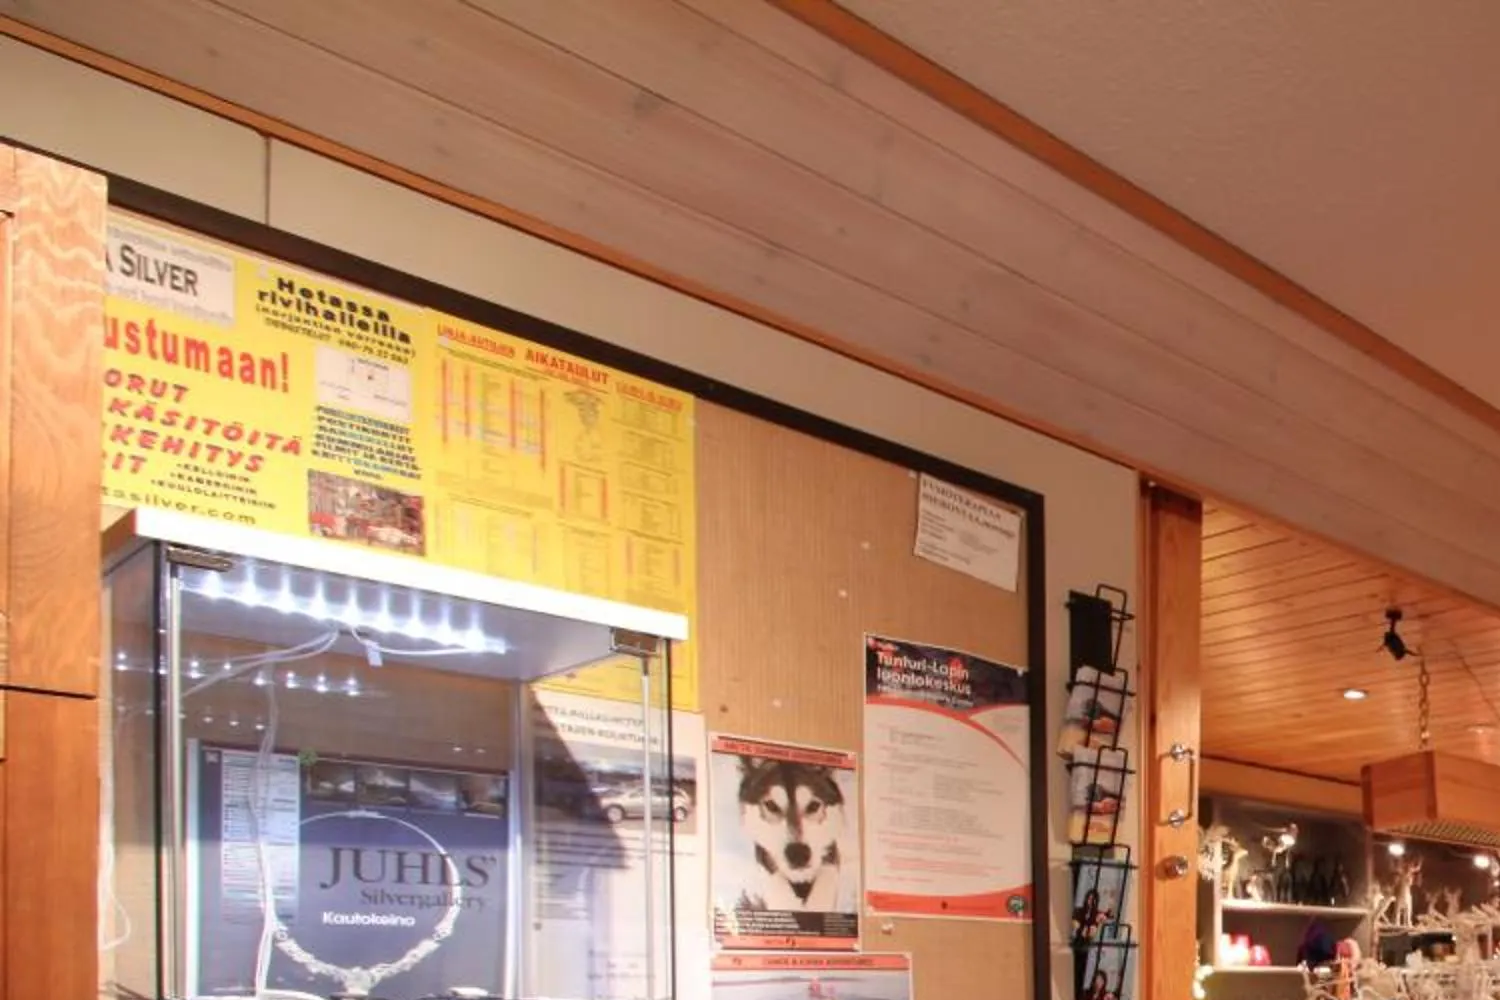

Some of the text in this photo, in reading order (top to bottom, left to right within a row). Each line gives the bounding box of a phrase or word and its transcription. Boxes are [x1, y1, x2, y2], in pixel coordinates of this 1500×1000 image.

[119, 243, 198, 296] SILVER
[103, 368, 189, 403] ORUT
[102, 420, 265, 472] KEHITYS
[108, 397, 302, 456] KÄSITÖITÄ
[323, 911, 416, 927] Kautokeino
[361, 888, 485, 911] Silvergallry
